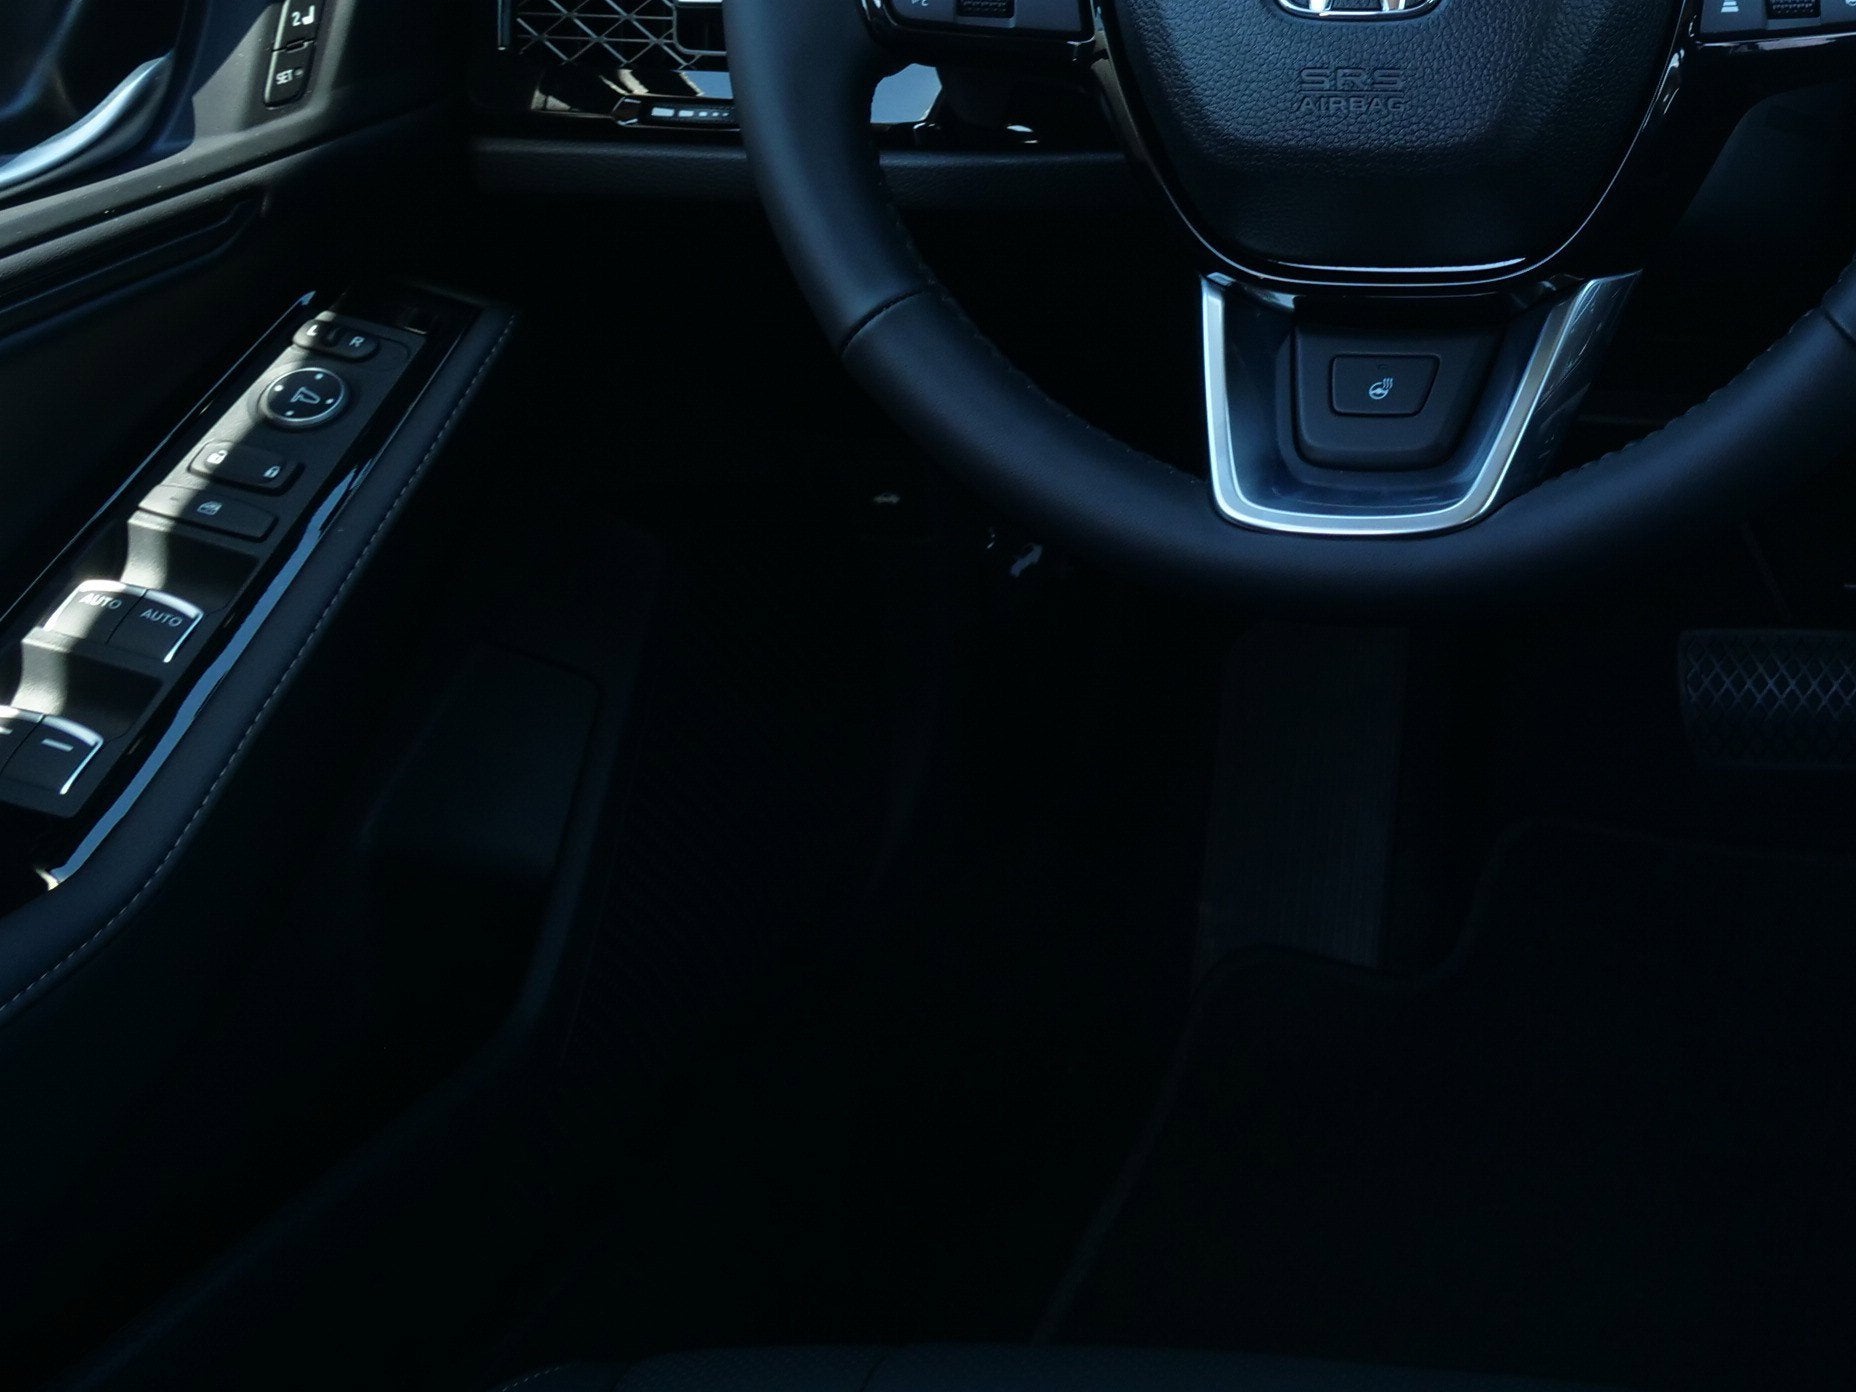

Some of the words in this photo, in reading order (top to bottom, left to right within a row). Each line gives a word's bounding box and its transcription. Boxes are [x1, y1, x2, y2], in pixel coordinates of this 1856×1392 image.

[291, 11, 301, 26] 2
[275, 70, 293, 85] SET
[1299, 67, 1401, 91] SRS
[350, 335, 364, 349] R
[78, 592, 123, 610] AUTO
[139, 608, 183, 627] AUTO
